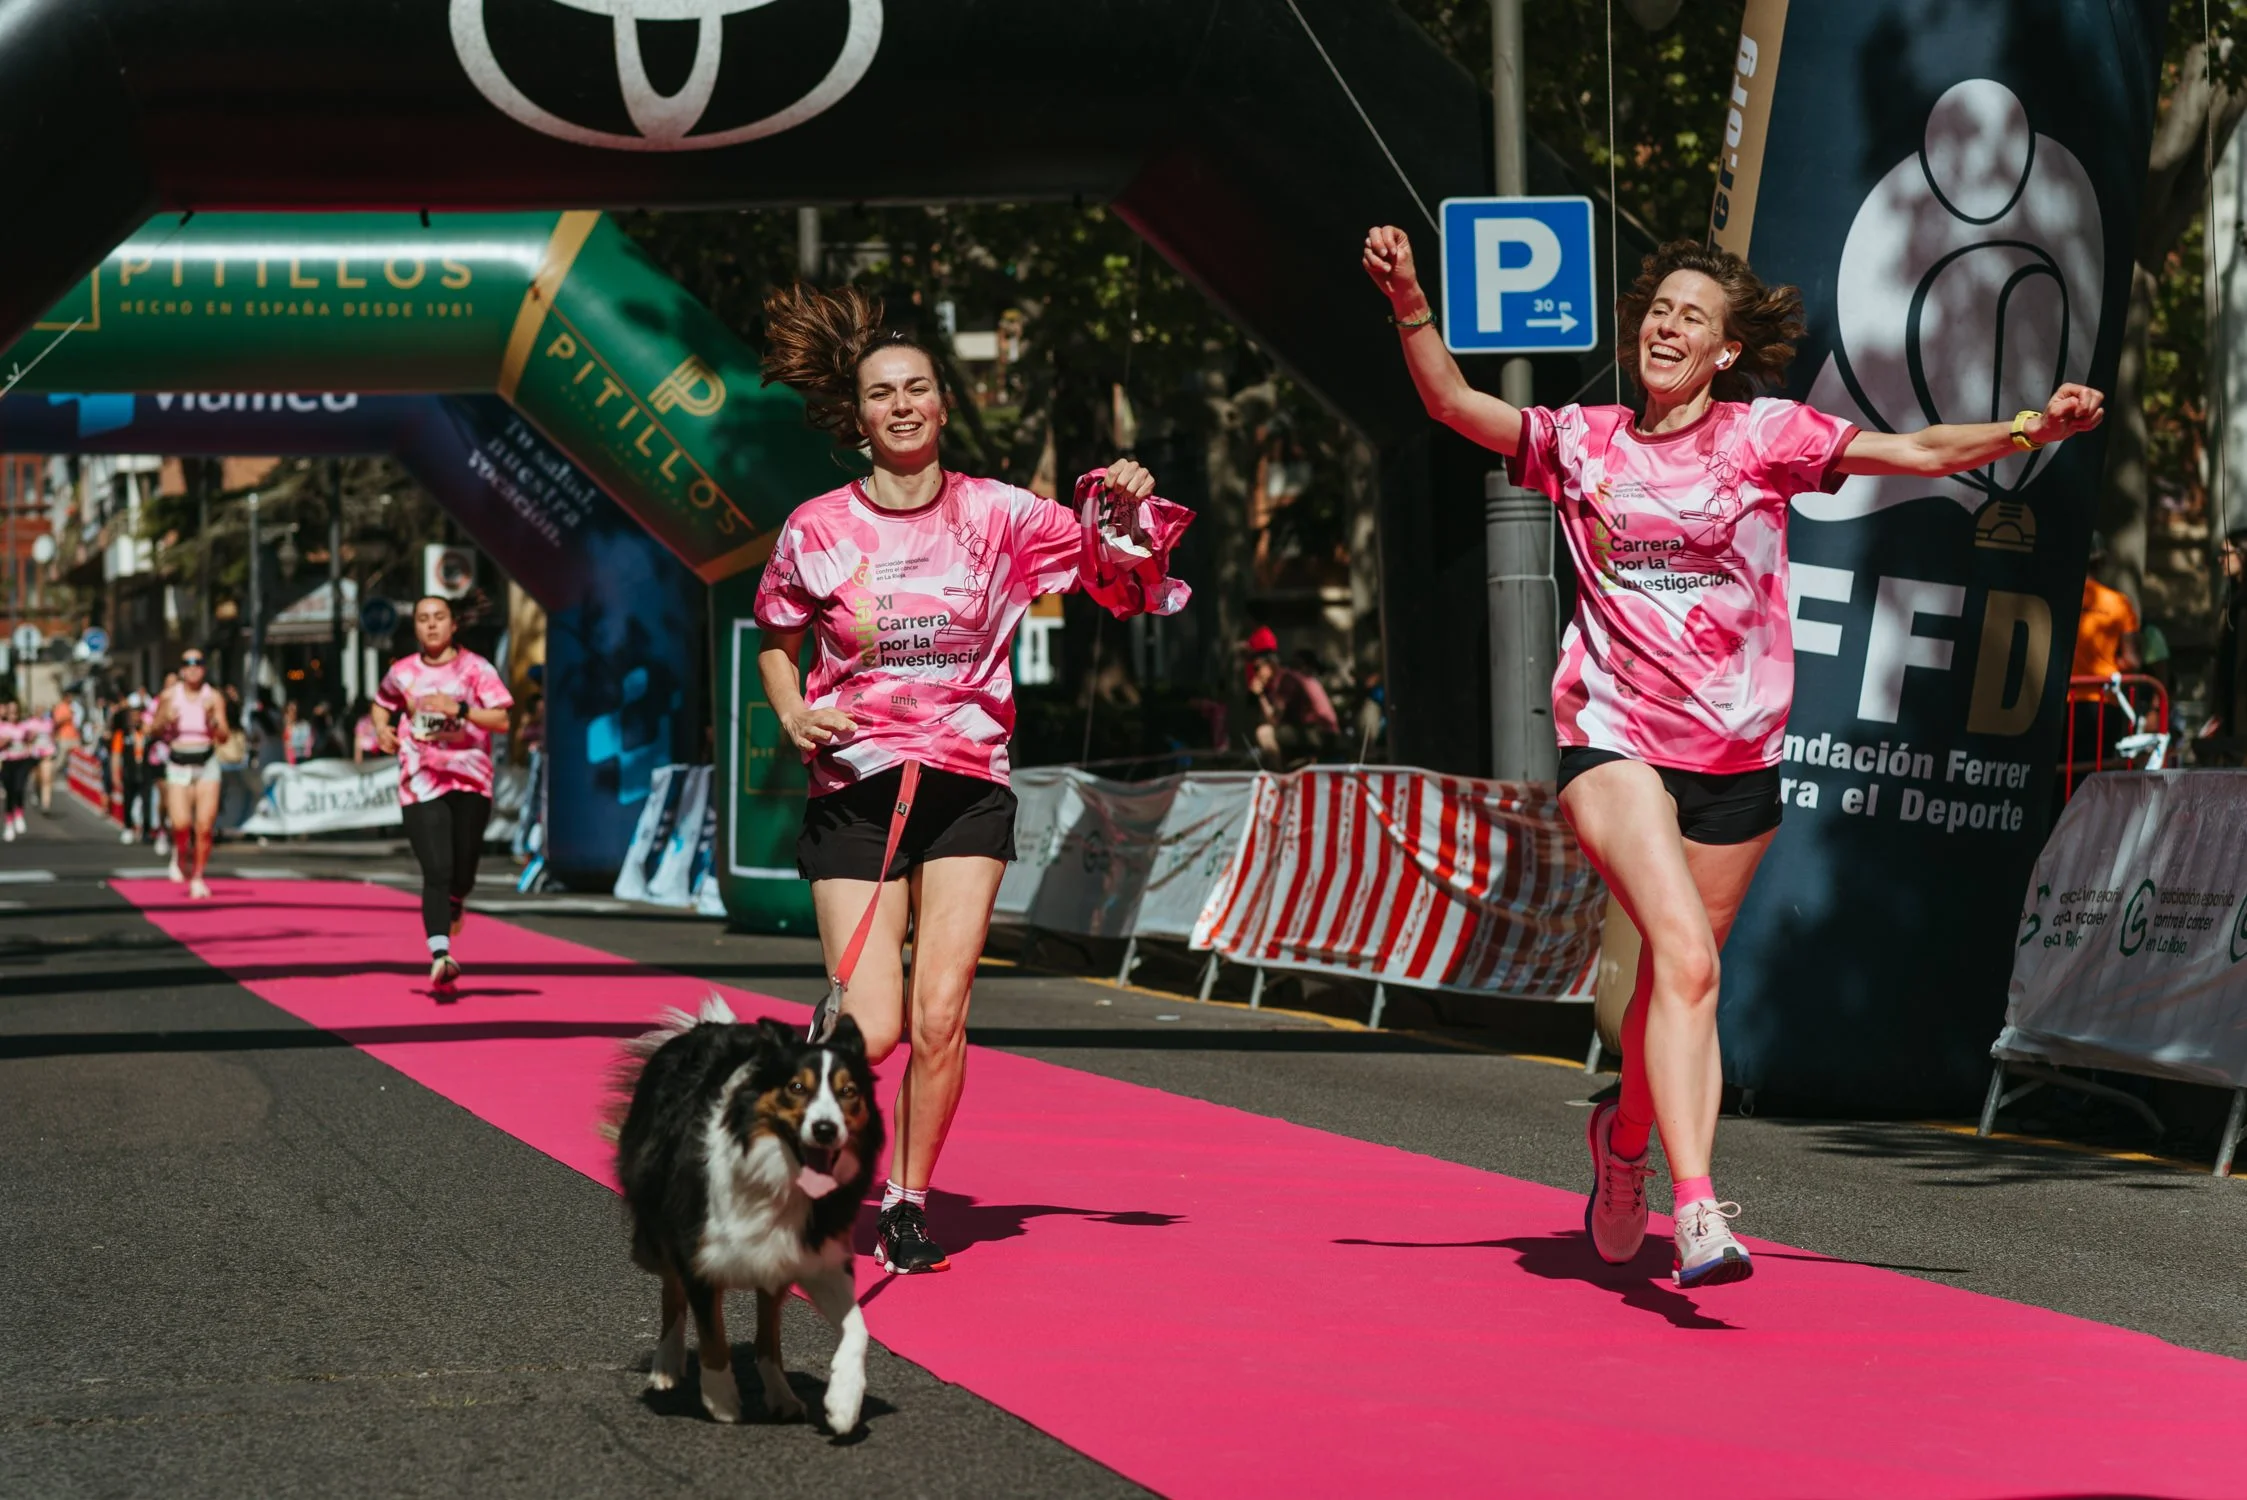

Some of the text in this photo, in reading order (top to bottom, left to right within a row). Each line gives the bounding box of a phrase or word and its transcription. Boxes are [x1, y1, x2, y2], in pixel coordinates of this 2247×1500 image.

[1473, 217, 1563, 334] P
[120, 298, 474, 319] HECHO EN ESPAÑA DESDE 1981
[1533, 298, 1573, 313] 30 m
[546, 332, 737, 536] PITILLOS
[487, 437, 581, 529] nuestra
[1610, 514, 1627, 530] XI
[1610, 536, 1681, 552] Carrera
[1614, 555, 1666, 576] por la
[875, 594, 893, 611] XI
[876, 613, 950, 632] Carrera
[879, 634, 931, 654] por la
[1783, 732, 2031, 789] ndación Ferrer
[1841, 783, 1880, 817] el
[1899, 788, 2024, 834] Deporte
